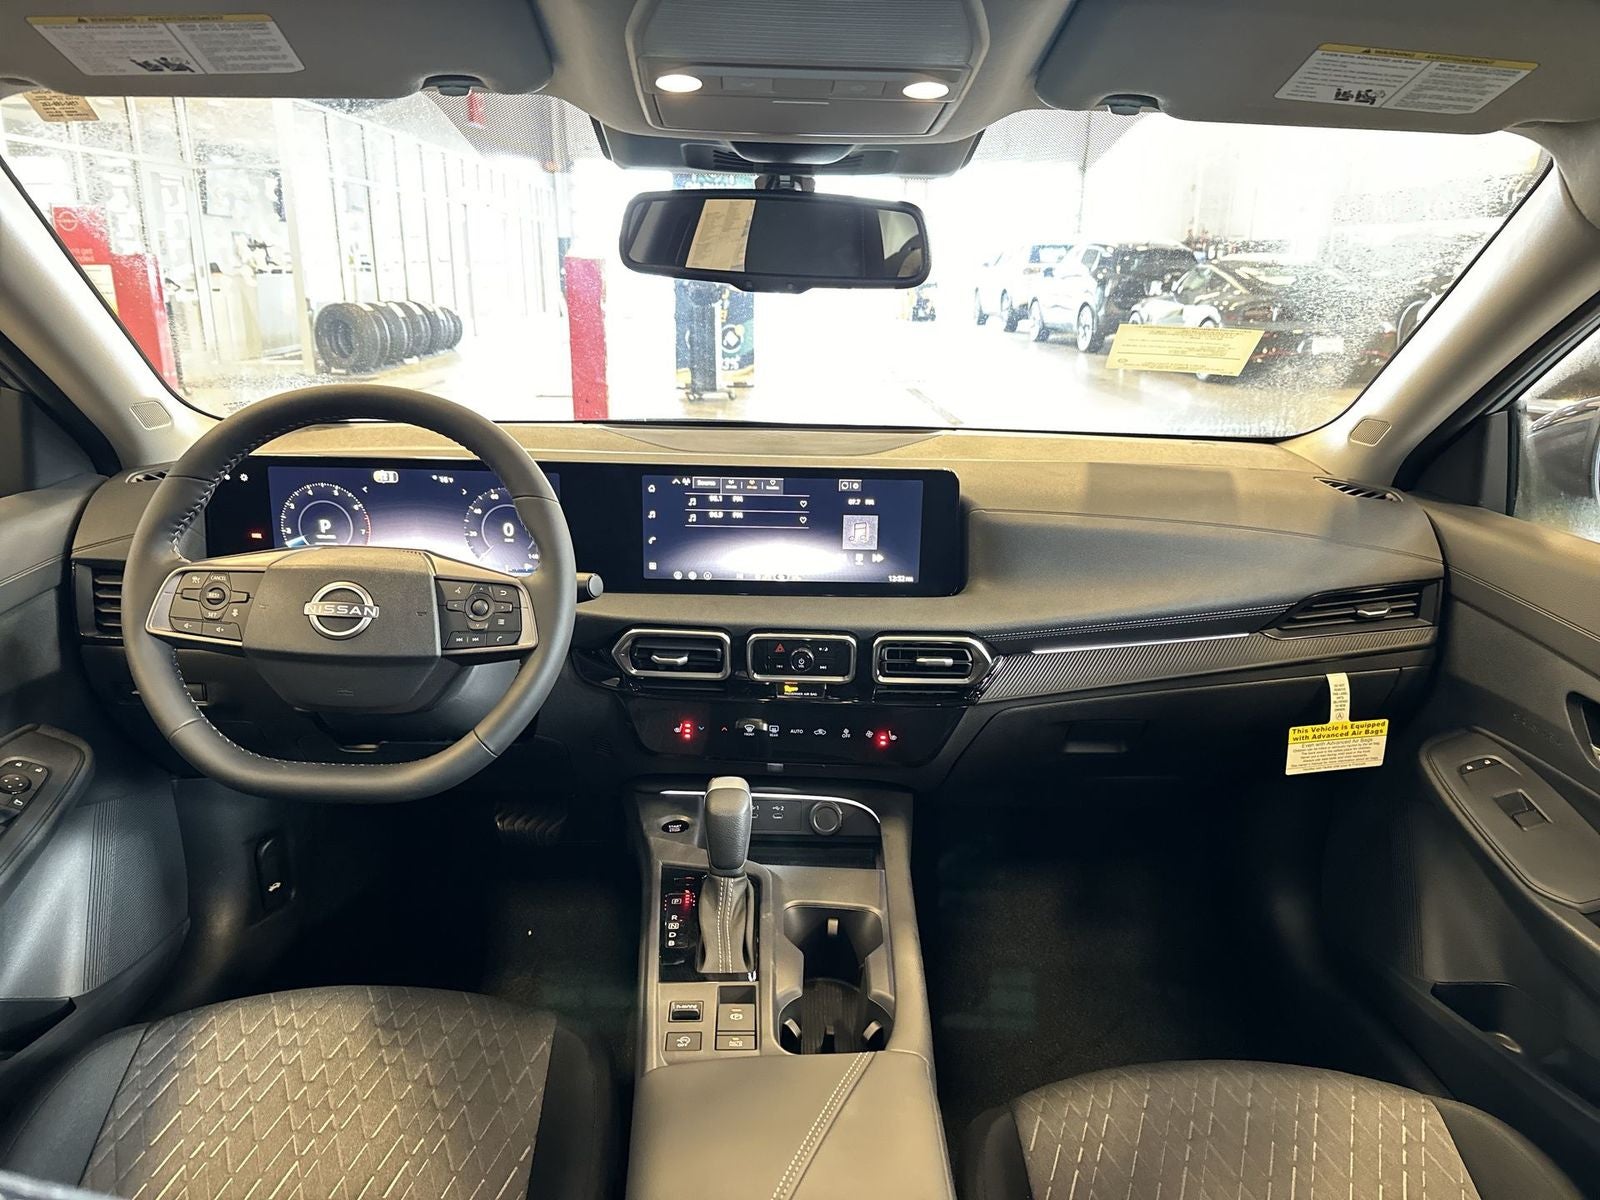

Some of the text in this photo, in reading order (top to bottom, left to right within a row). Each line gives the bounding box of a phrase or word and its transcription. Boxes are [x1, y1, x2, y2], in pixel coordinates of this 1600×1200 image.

[319, 518, 332, 534] P
[502, 521, 515, 537] 0
[305, 603, 377, 618] NISSAN
[1311, 725, 1339, 733] Vehicle
[1350, 721, 1386, 730] Equipped
[1312, 731, 1349, 740] Advanced
[1364, 728, 1384, 736] Bags
